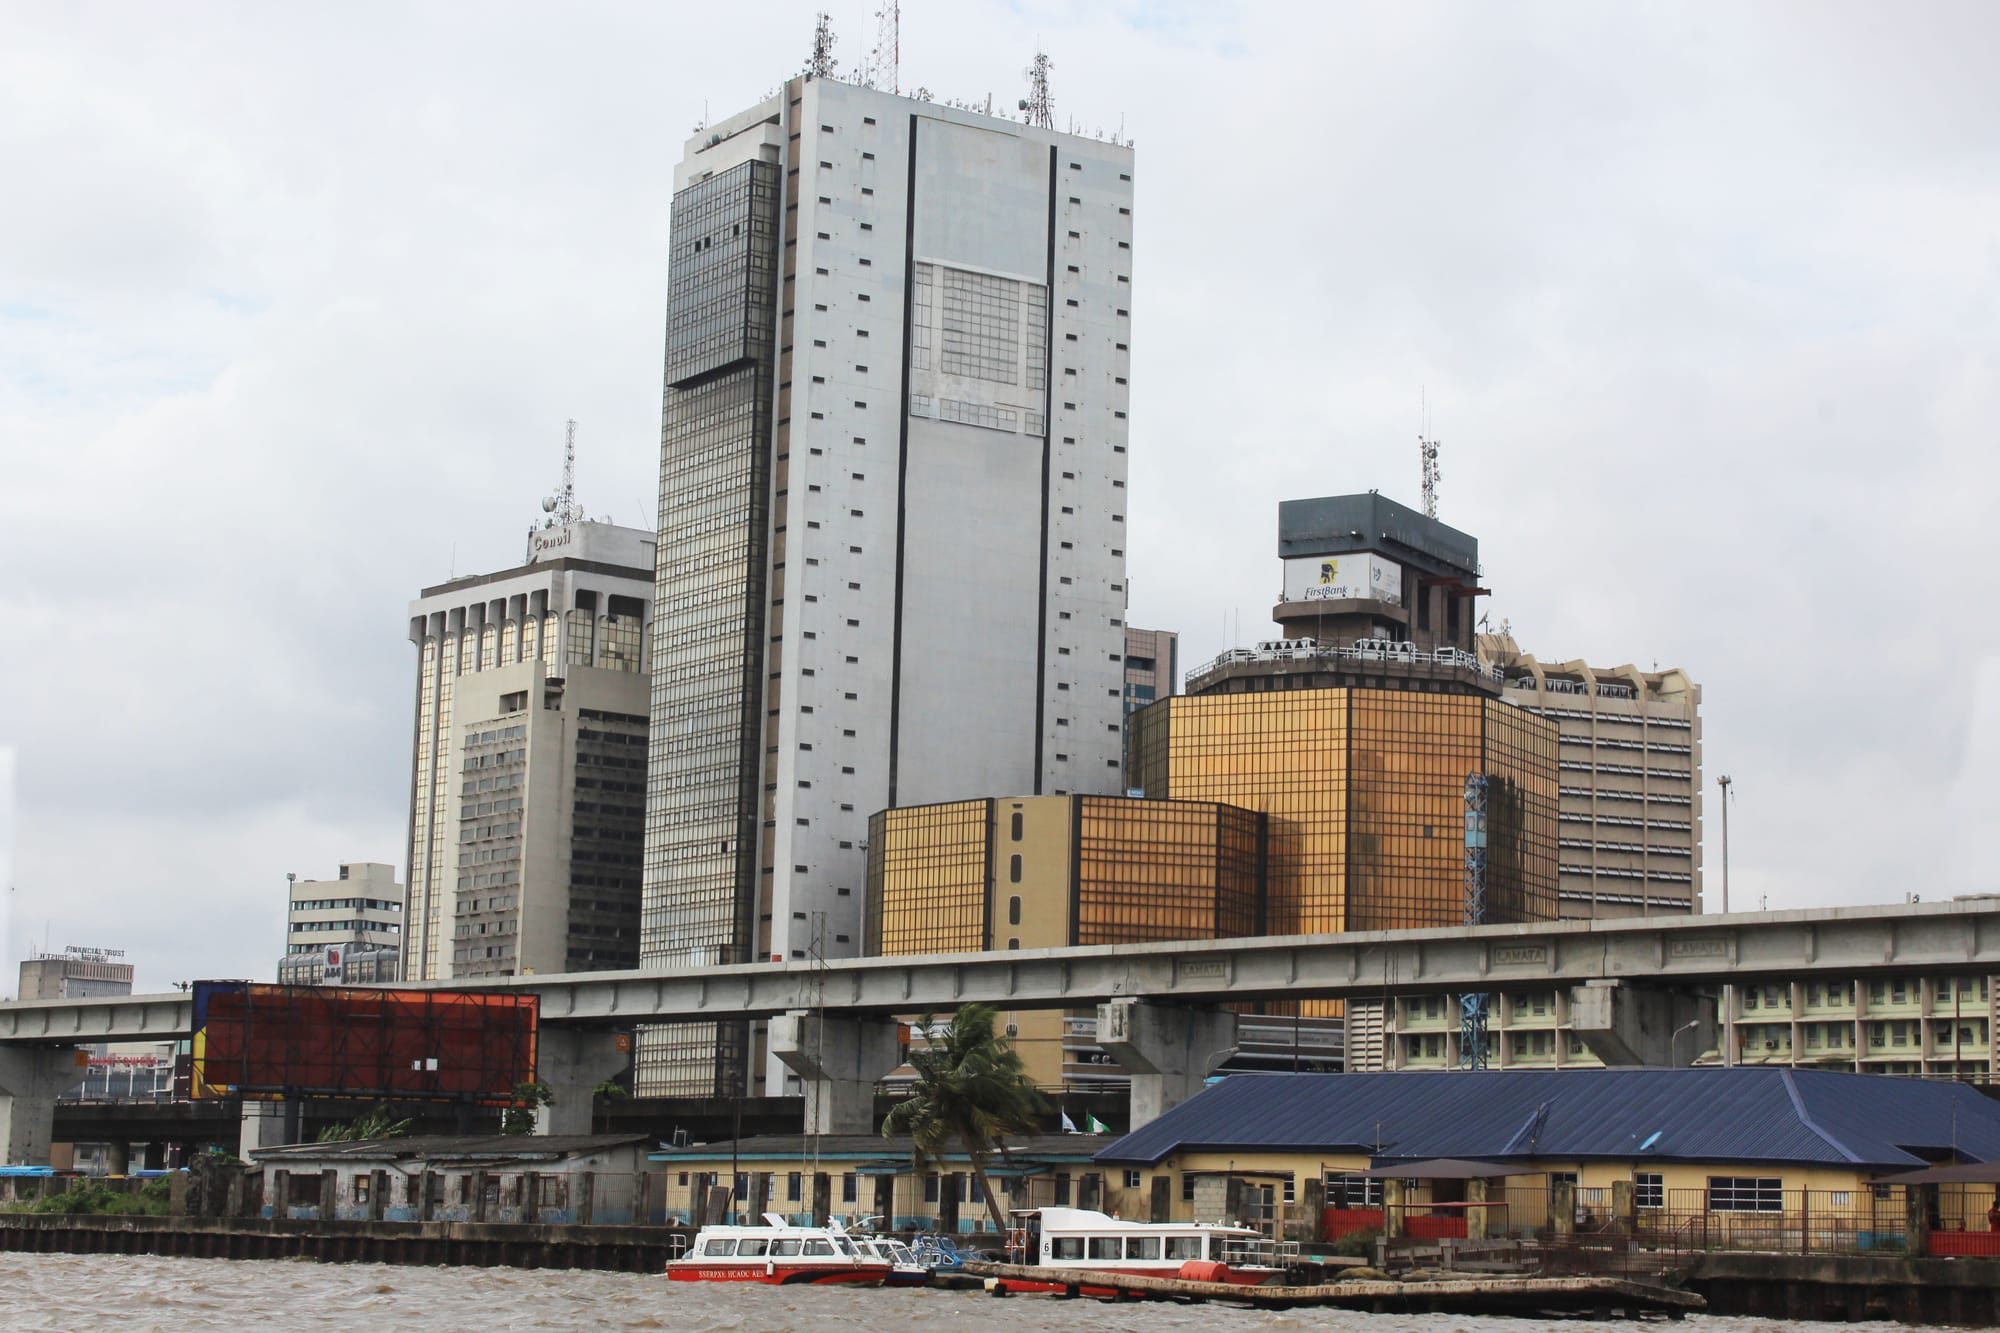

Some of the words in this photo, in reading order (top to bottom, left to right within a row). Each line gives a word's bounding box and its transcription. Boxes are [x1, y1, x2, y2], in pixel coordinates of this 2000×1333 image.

[1305, 586, 1348, 597] FirstBank
[65, 945, 102, 955] FINANCIAL
[104, 949, 125, 957] TRUST
[1497, 949, 1544, 961] LAMATA
[1044, 1242, 1050, 1252] 6
